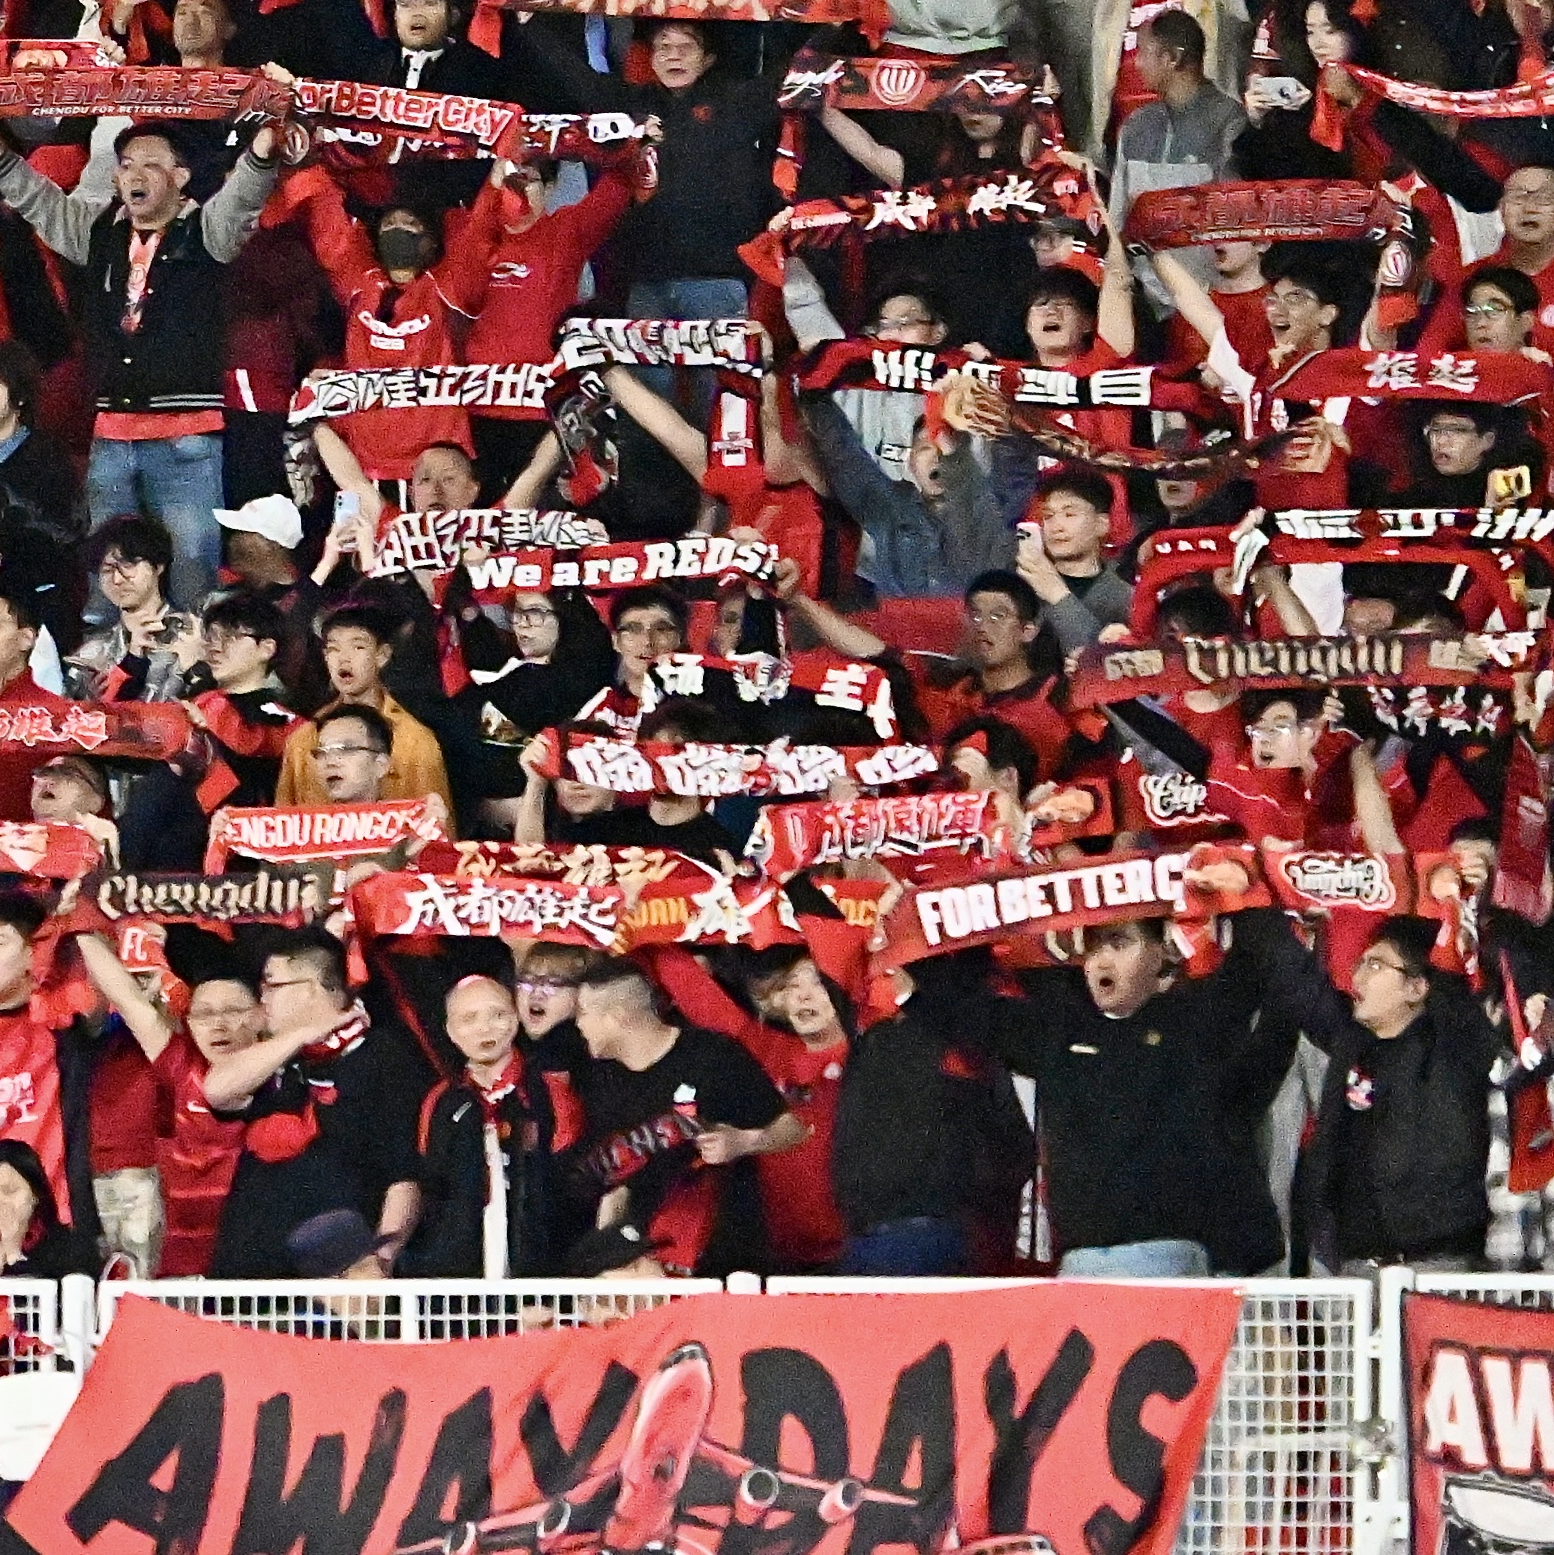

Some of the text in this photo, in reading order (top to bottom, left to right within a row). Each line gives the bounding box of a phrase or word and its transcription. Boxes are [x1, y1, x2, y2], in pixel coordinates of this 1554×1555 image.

[332, 78, 439, 127] Better
[469, 551, 632, 589] We are
[404, 876, 621, 948] 成都雄起
